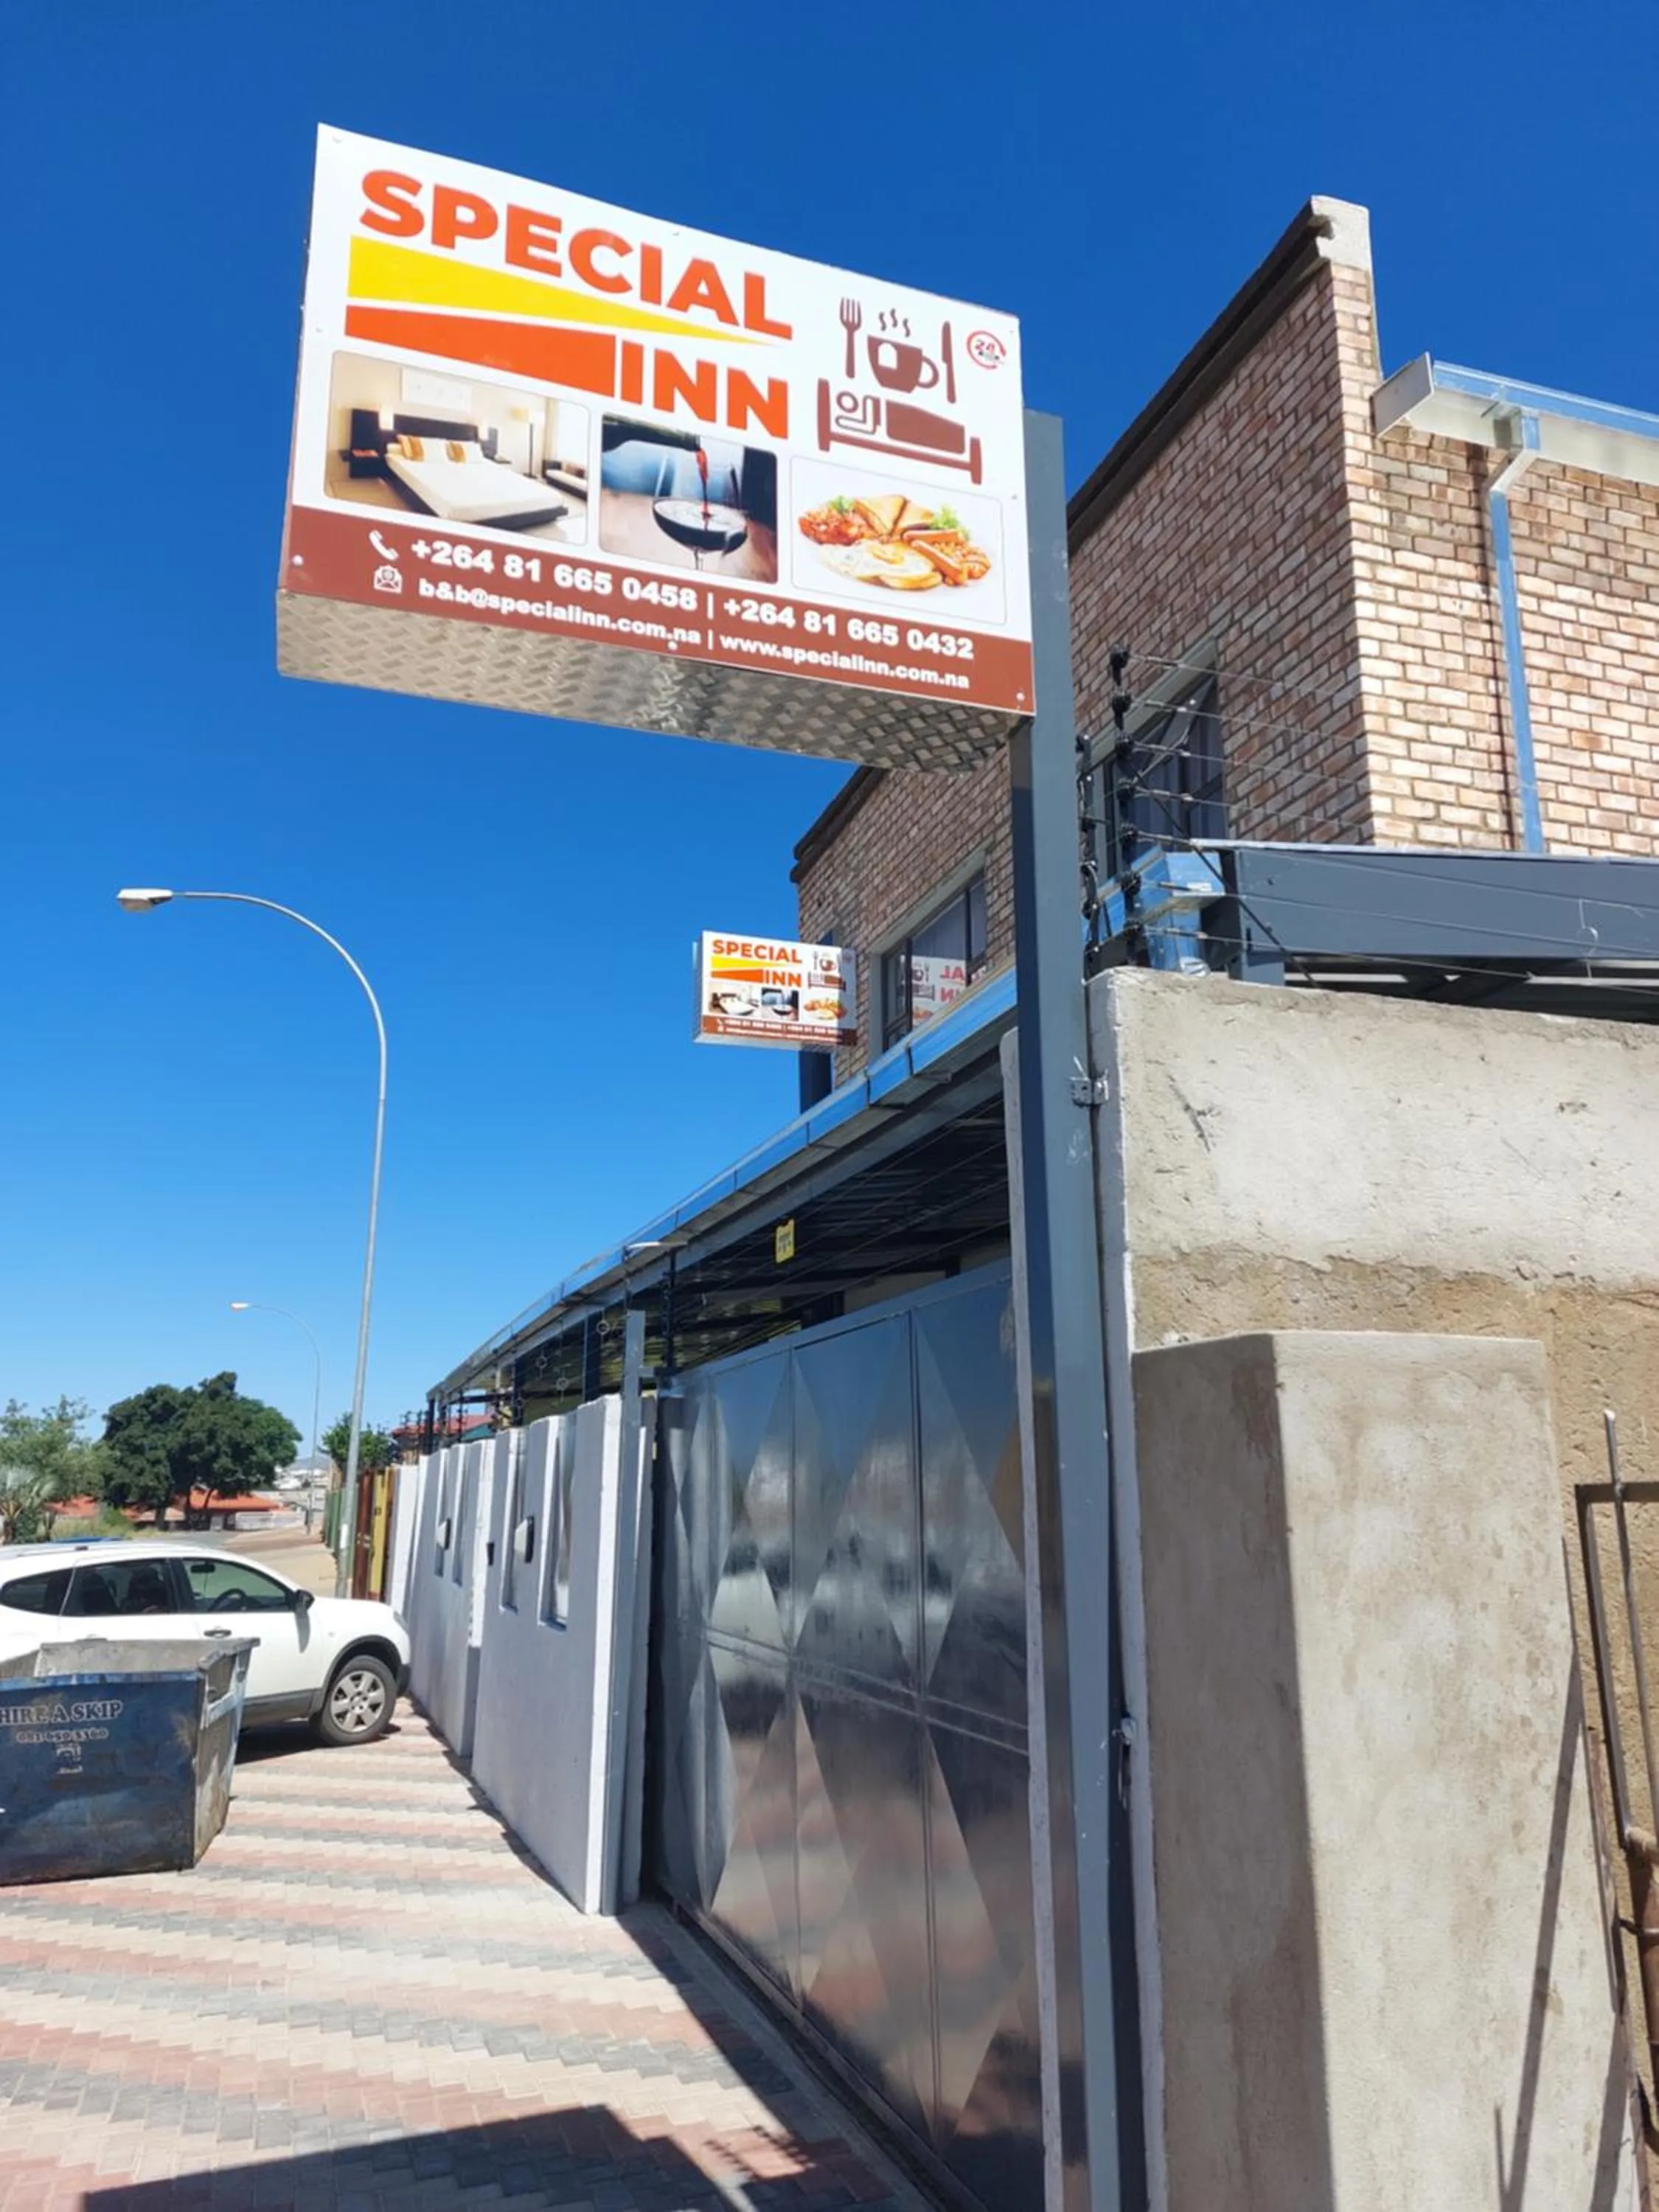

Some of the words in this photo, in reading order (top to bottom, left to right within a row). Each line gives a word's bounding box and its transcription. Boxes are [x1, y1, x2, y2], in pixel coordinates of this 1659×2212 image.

[359, 170, 792, 340] SPECIAL
[620, 339, 788, 439] INN
[411, 540, 493, 573] +264
[504, 554, 541, 582] 81
[554, 563, 613, 595] 665
[622, 577, 698, 611] 0458
[724, 599, 795, 628] +264
[804, 611, 835, 636] 81
[847, 619, 899, 646] 665
[907, 630, 973, 659] 0432
[419, 579, 700, 644] b&b@specialinn.com.na
[720, 636, 970, 689] www.specialinn.com.na
[712, 939, 802, 964] SPECIAL
[766, 970, 802, 987] INN
[51, 1703, 70, 1723] A
[72, 1700, 123, 1722] SKIP
